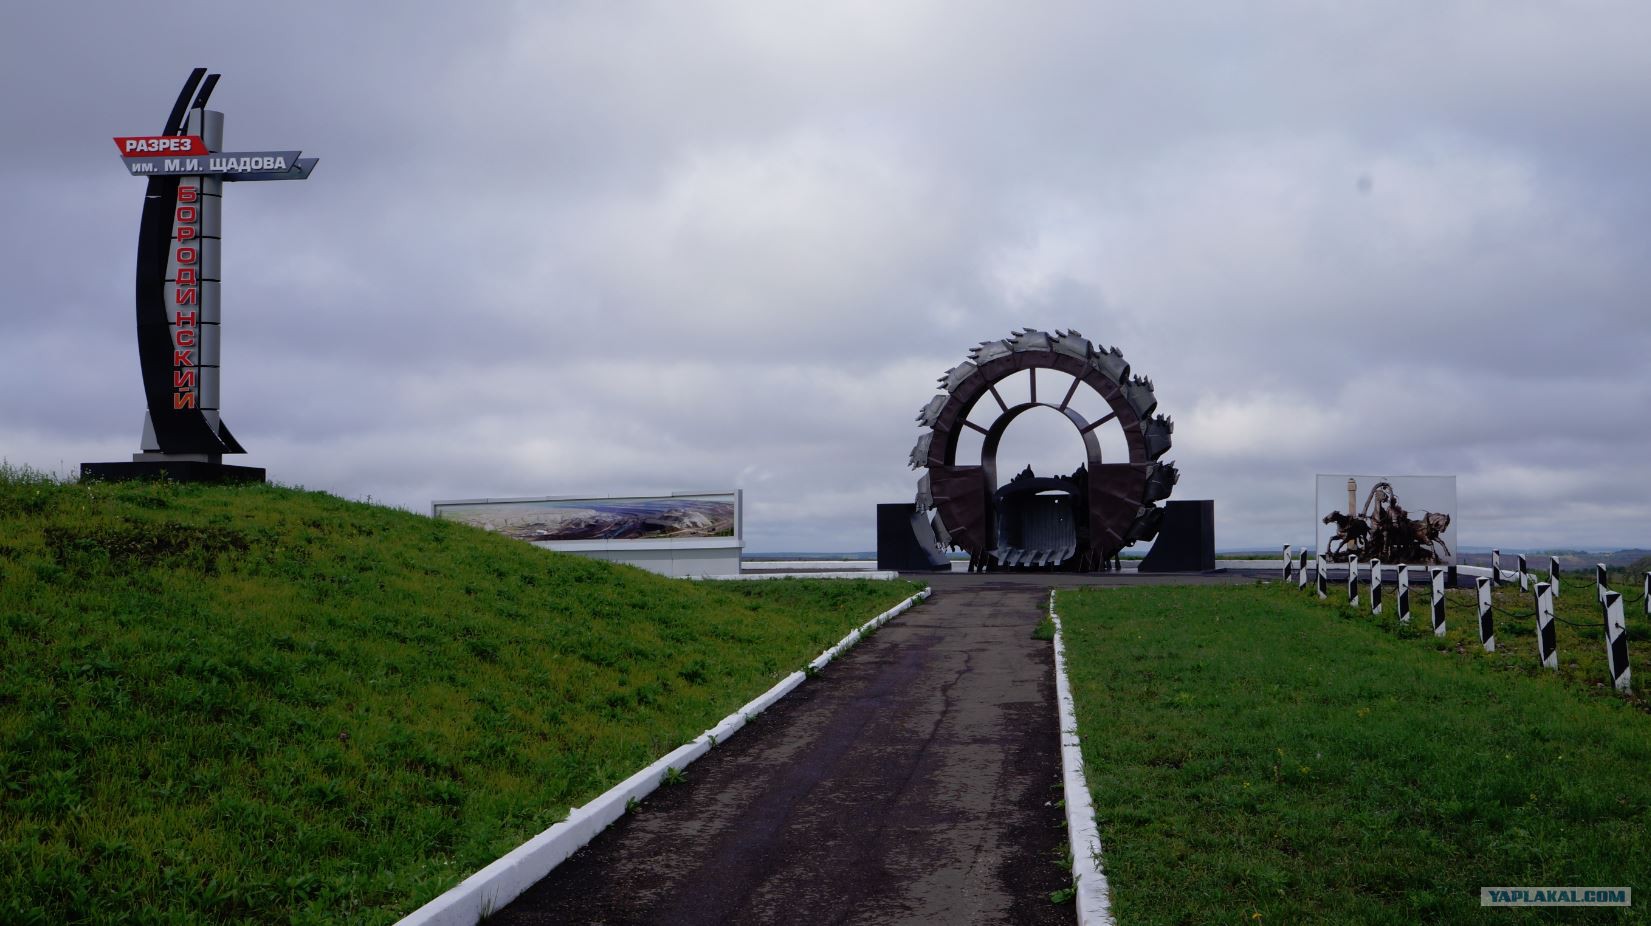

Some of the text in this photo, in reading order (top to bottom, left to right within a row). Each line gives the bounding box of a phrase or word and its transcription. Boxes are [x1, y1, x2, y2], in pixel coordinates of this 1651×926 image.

[125, 138, 192, 153] РАЗРЕЗ
[164, 159, 203, 172] М.И.
[209, 156, 287, 173] ЩАДОВА
[173, 186, 197, 410] БОРОДИНСКИЙ
